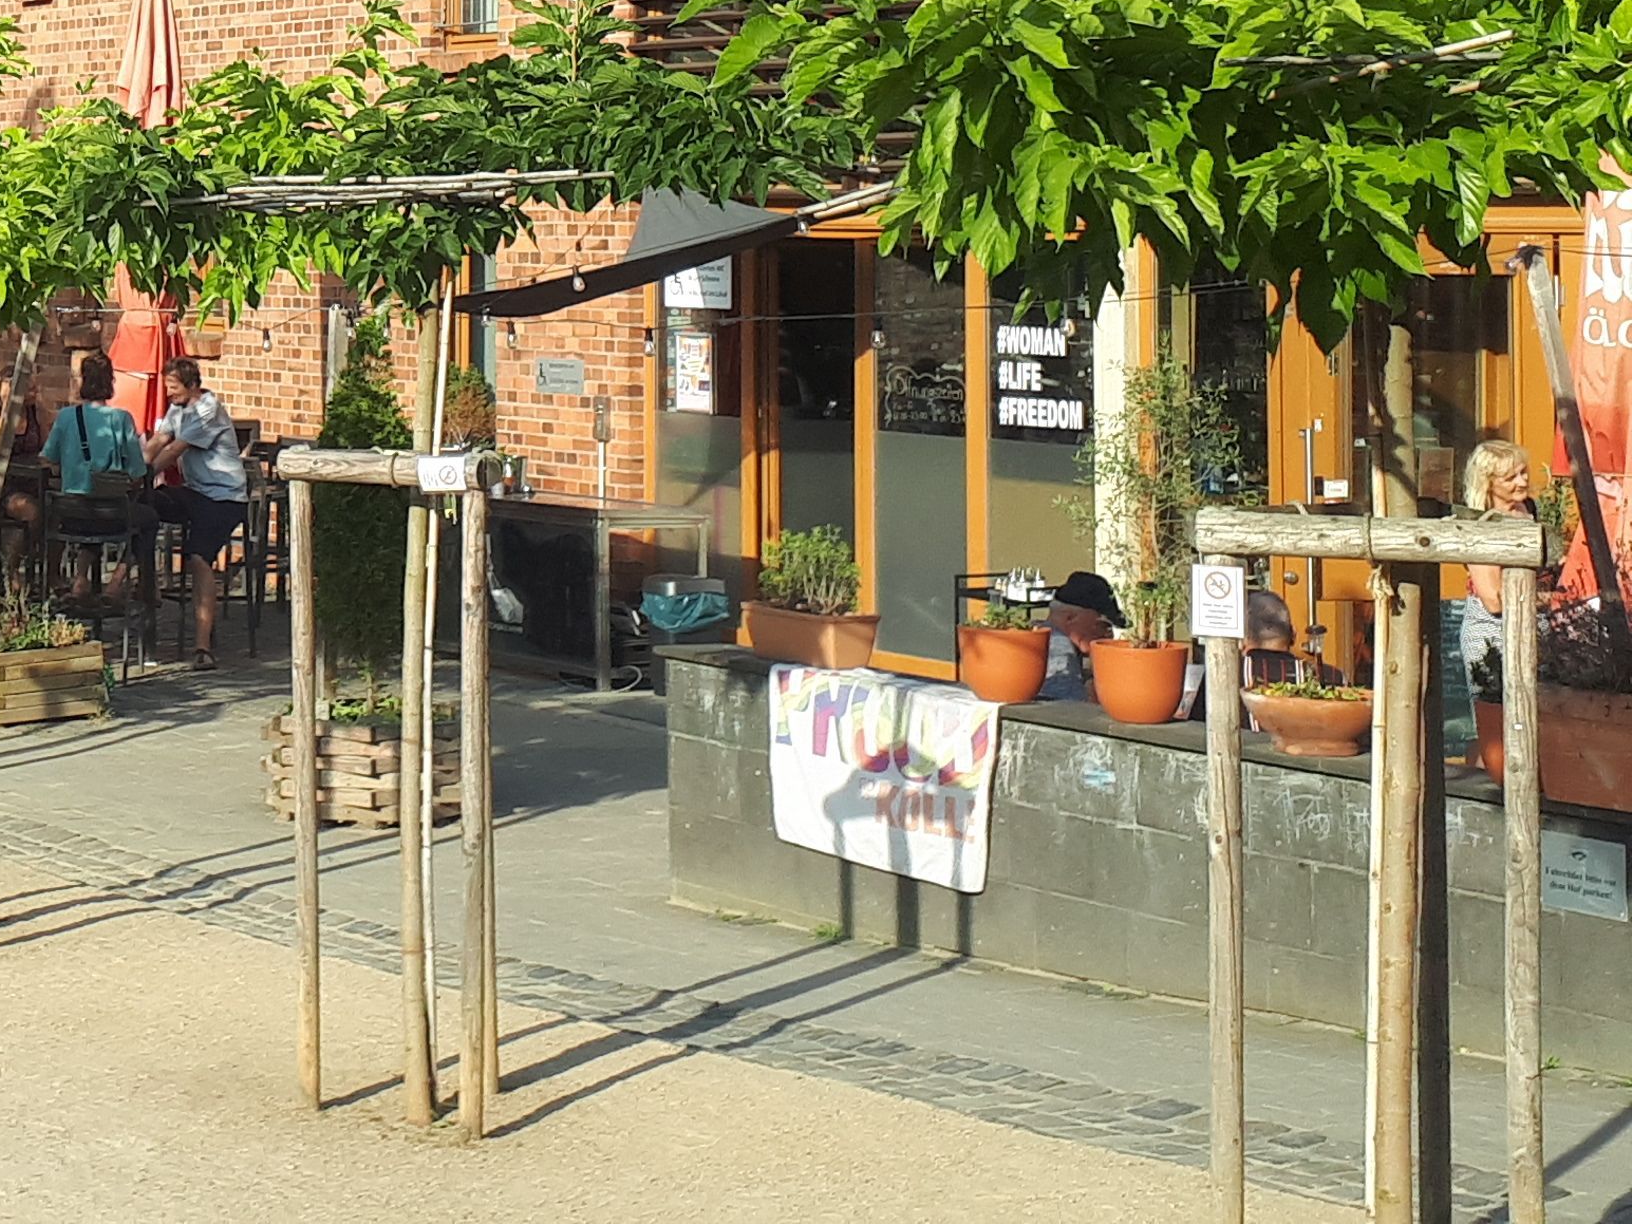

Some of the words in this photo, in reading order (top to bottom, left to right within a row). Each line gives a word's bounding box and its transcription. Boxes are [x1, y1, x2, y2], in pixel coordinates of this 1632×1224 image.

[997, 324, 1066, 357] #WOMAN
[999, 360, 1042, 391] #LIFE
[999, 396, 1084, 430] #FREEDOM
